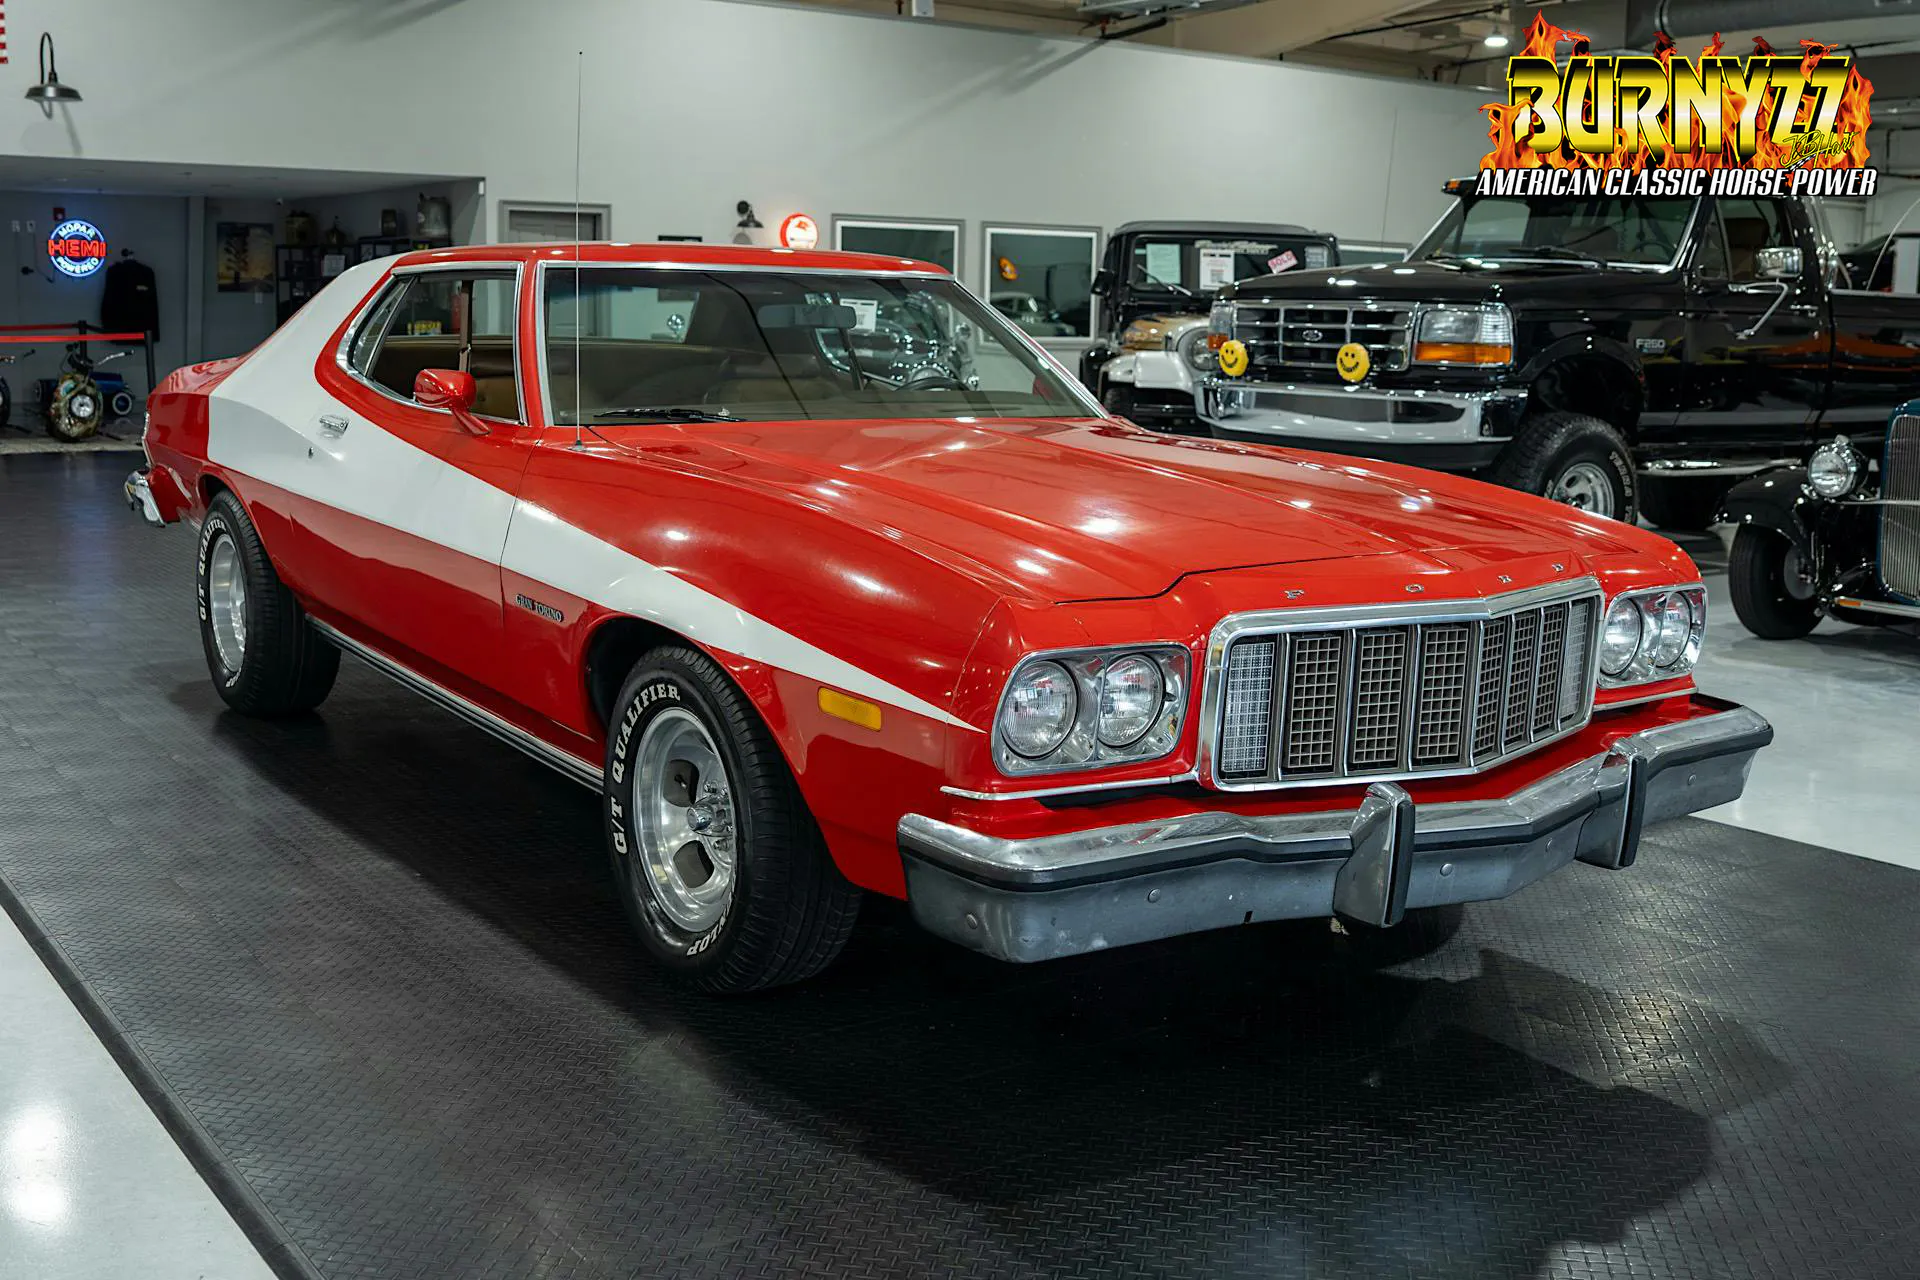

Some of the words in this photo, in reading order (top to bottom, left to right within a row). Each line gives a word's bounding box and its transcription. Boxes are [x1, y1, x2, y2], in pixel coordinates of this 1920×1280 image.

[58, 222, 96, 237] MOPAR
[47, 239, 107, 257] HEMI
[1270, 252, 1295, 269] SOLD
[56, 256, 99, 274] POWERED
[199, 519, 227, 576] QUALIFIER
[199, 583, 207, 621] G/T
[516, 594, 532, 611] GRAN
[534, 602, 562, 622] TORINO
[612, 683, 680, 784] QUALIFIER
[611, 796, 627, 855] G/T
